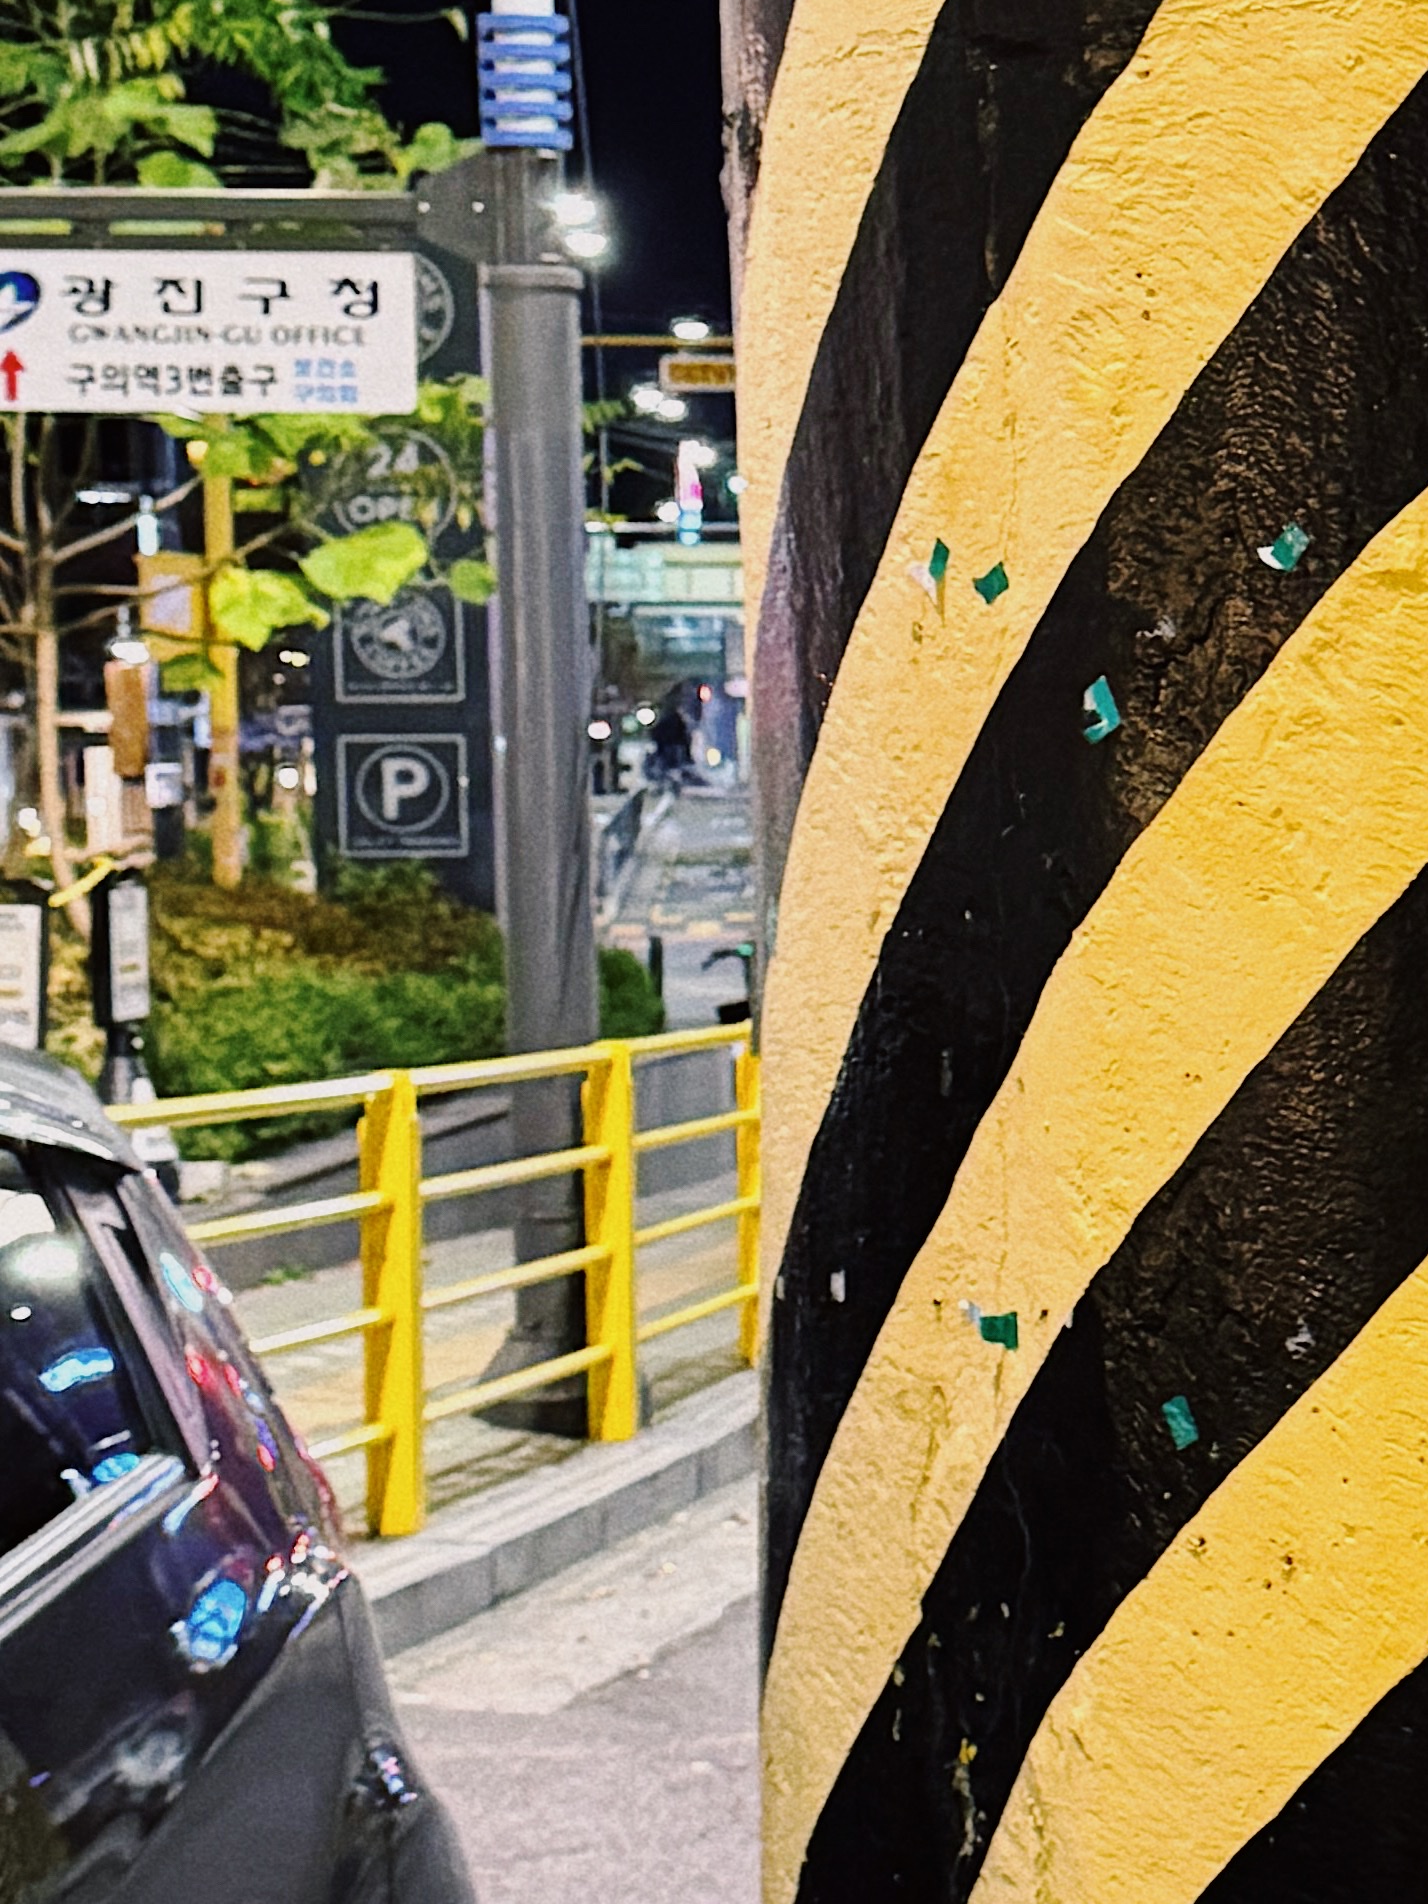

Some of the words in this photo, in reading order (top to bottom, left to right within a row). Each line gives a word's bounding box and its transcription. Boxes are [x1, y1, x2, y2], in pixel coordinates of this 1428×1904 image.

[65, 276, 379, 318] 광진구청
[68, 325, 262, 346] GWANGJIN-GU
[271, 325, 366, 346] OFFICE
[66, 363, 278, 397] 구의역3번출구
[366, 440, 419, 480] 24
[381, 757, 430, 821] P
